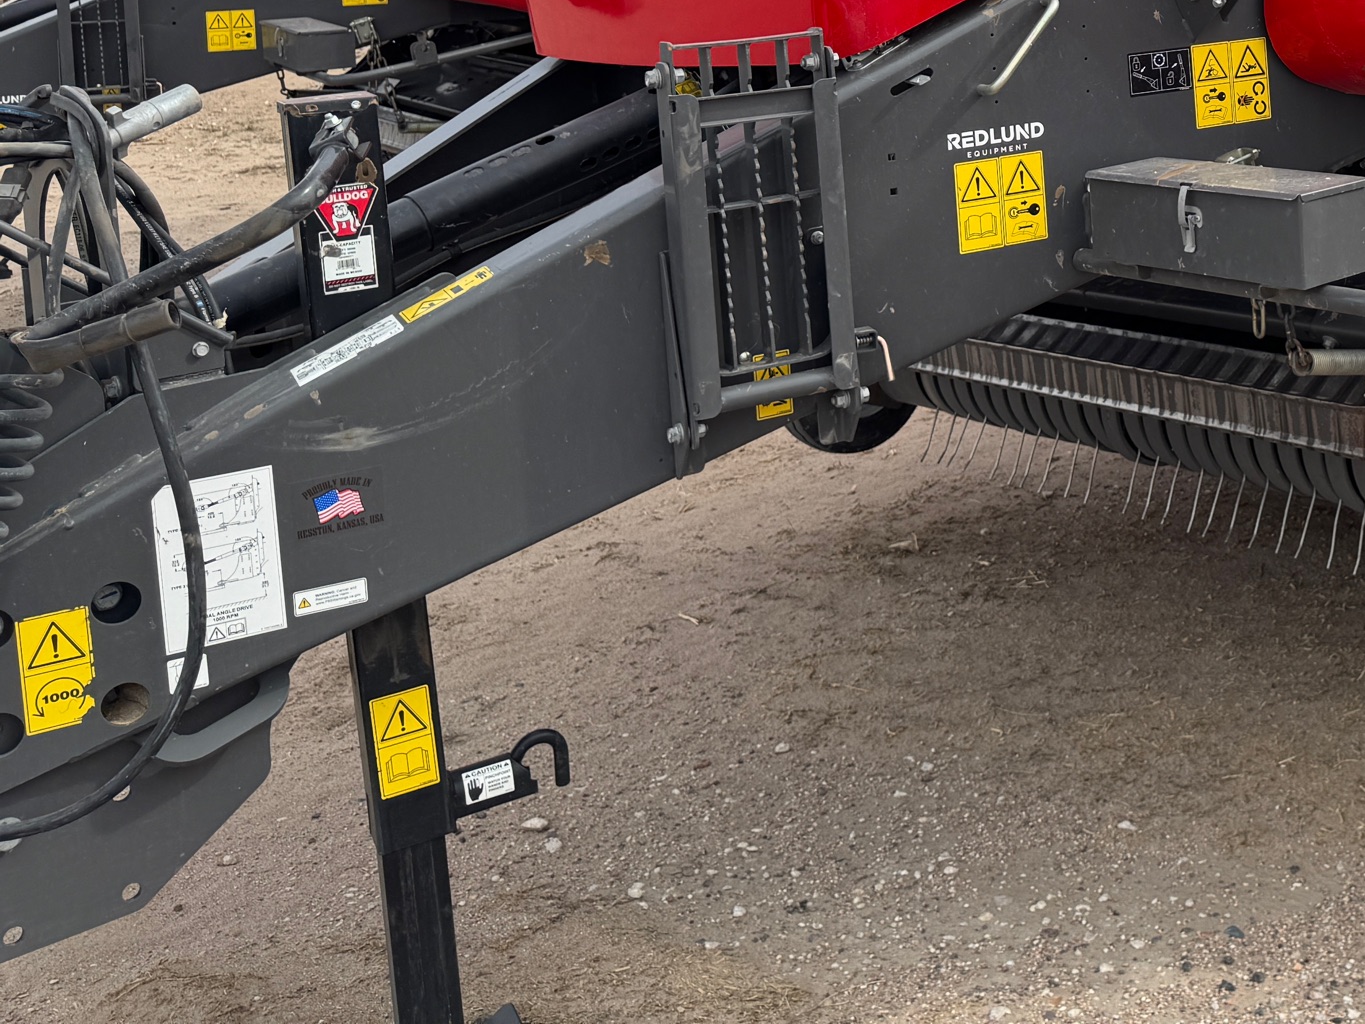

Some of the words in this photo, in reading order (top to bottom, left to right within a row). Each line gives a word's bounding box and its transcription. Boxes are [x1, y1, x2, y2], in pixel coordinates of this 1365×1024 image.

[946, 121, 1045, 151] REDLUND
[967, 143, 1028, 159] EQUIPMENT
[342, 184, 368, 192] TRUSTED
[301, 479, 337, 500] PROUDLY
[340, 477, 362, 486] MADE
[362, 478, 373, 487] IN
[297, 525, 335, 540] HESSTON,
[337, 517, 368, 531] KANSAS,
[369, 514, 384, 524] USA
[217, 608, 236, 616] ANGLE
[237, 604, 254, 612] DRIVE
[42, 688, 80, 705] 1000
[471, 763, 503, 777] CAUTION
